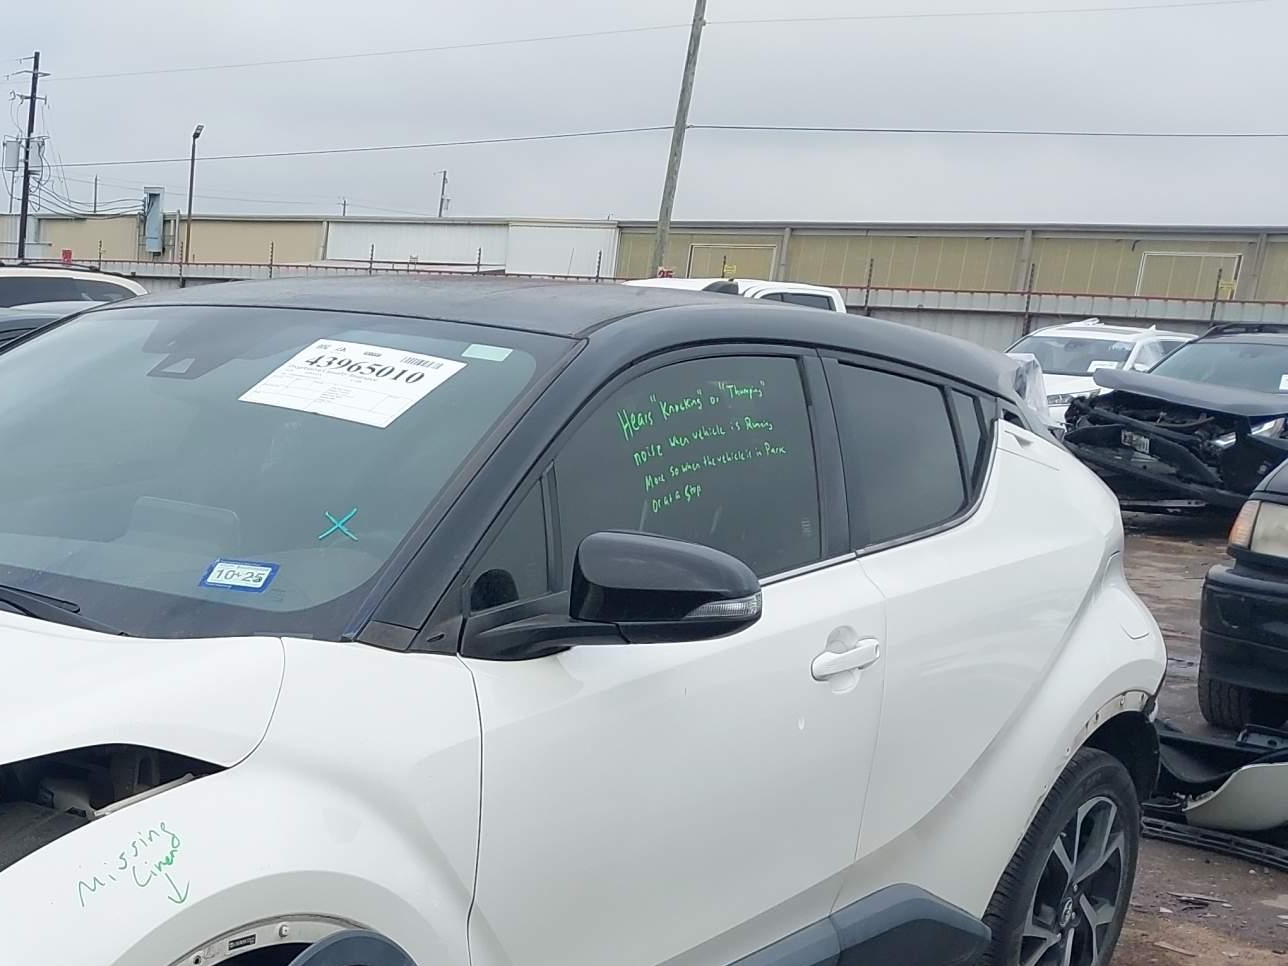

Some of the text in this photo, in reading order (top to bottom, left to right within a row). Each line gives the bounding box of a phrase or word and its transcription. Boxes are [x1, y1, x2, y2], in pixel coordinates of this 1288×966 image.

[304, 354, 425, 385] 43965010
[616, 408, 654, 441] Hears
[633, 443, 663, 467] noise
